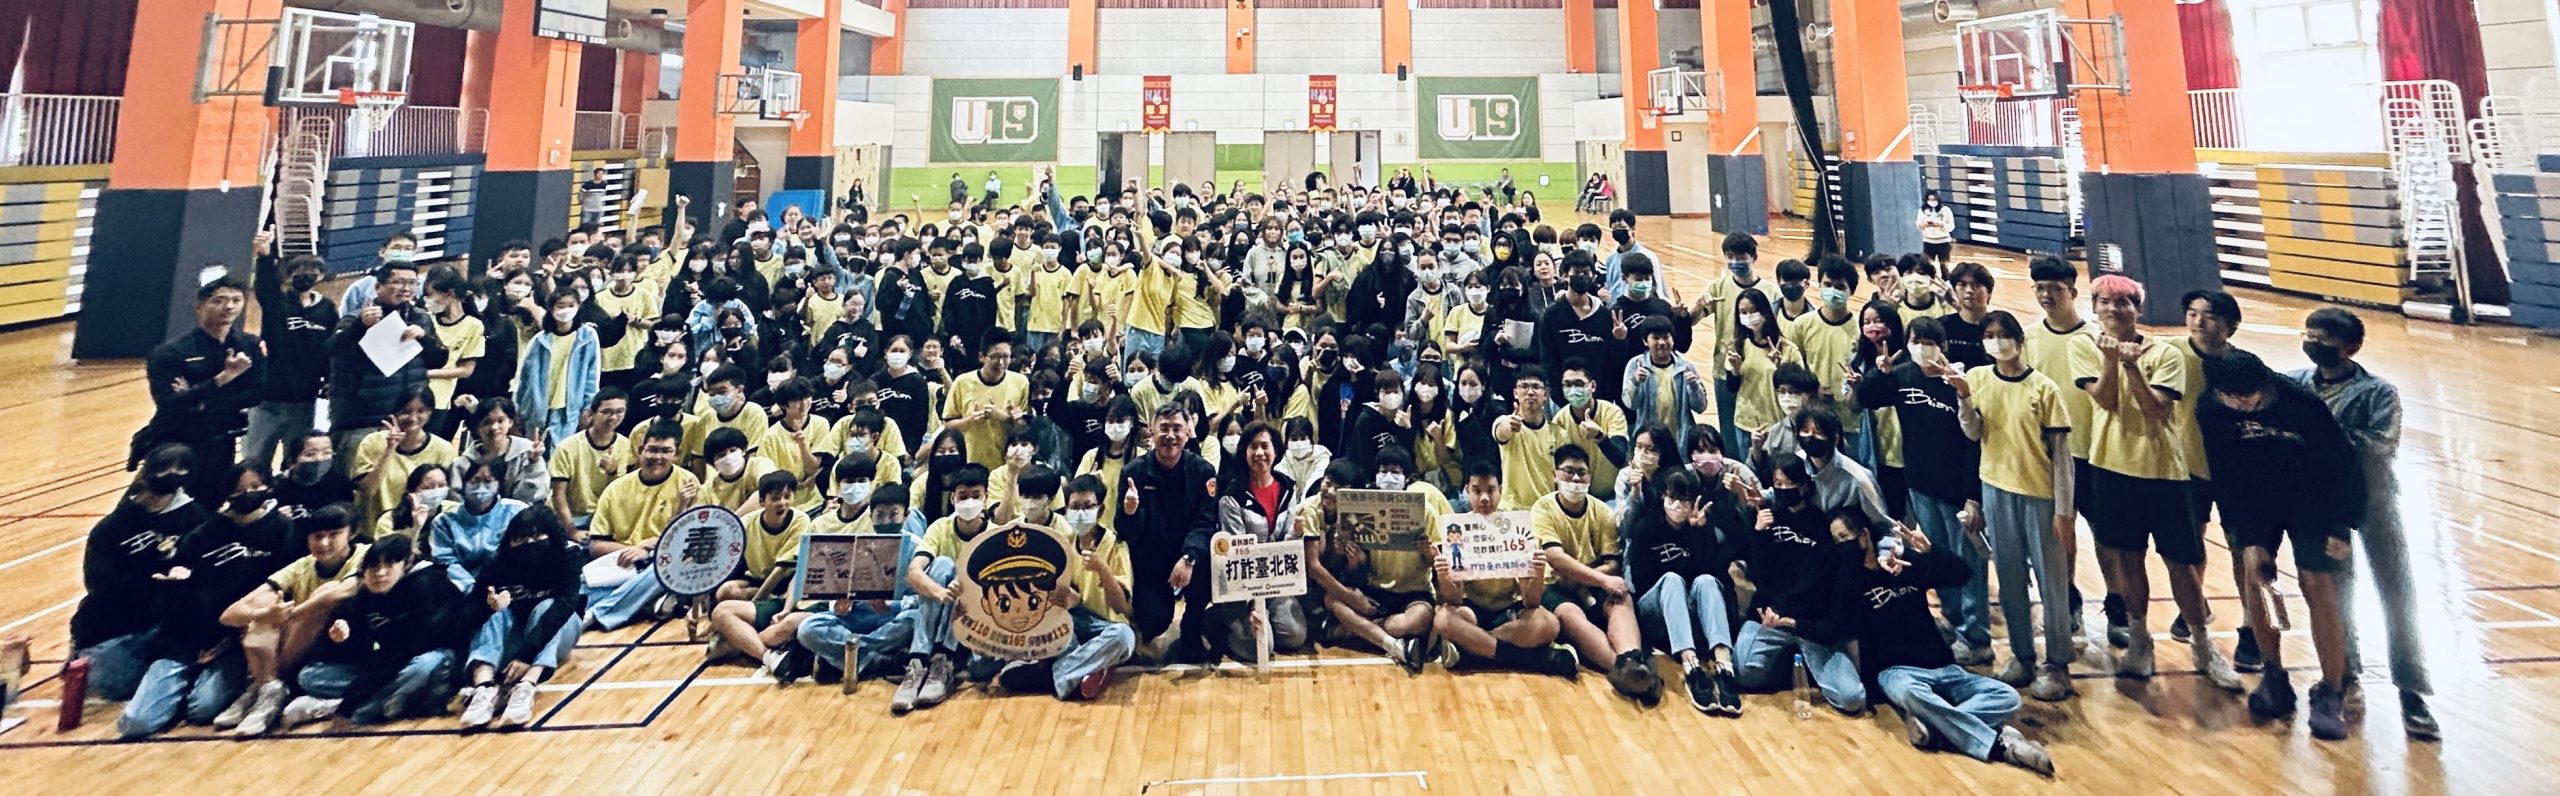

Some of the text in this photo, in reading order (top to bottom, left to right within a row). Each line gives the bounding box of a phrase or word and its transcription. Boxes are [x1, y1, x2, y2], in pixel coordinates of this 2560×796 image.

[953, 97, 1038, 143] U19
[1438, 96, 1519, 139] U19
[1225, 553, 1299, 582] 打詐臺北隊
